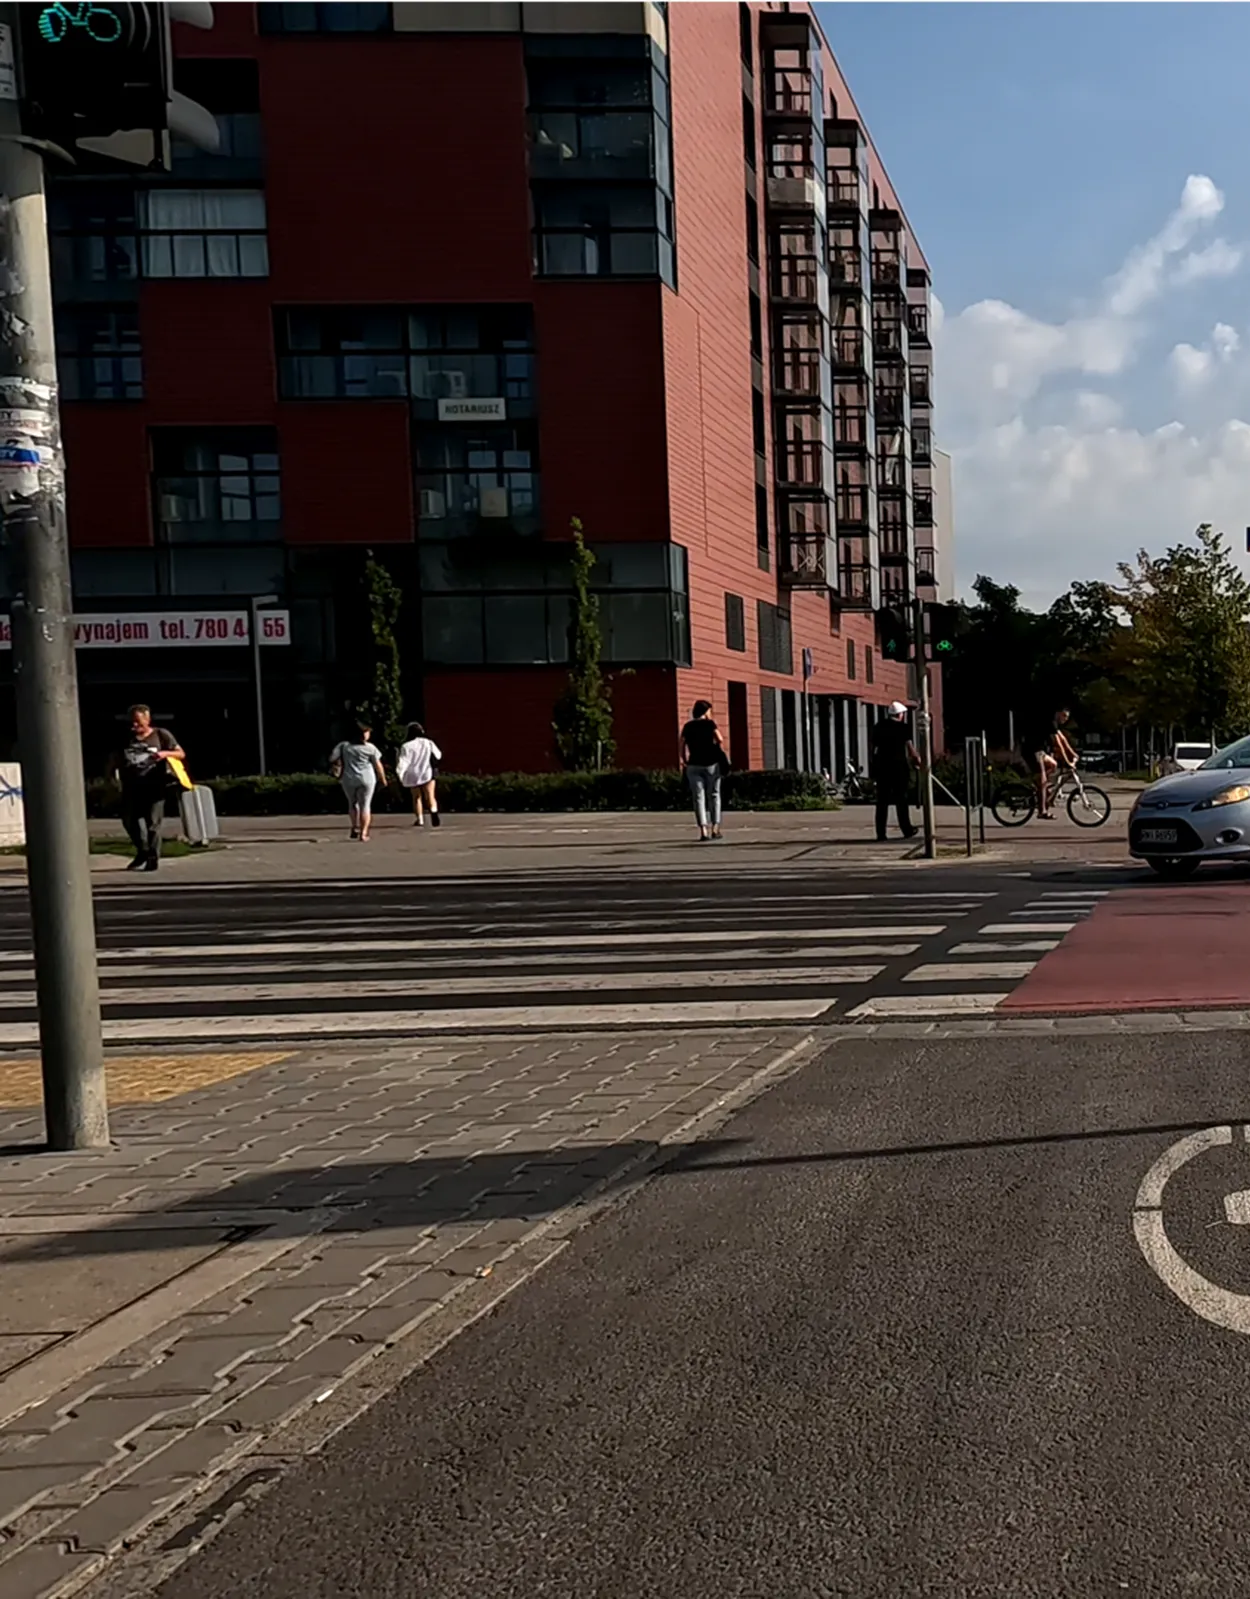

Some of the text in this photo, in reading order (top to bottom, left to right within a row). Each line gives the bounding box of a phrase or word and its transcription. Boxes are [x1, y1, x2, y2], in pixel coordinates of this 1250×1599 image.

[445, 404, 500, 414] NOTARIUSZ
[159, 619, 190, 640] tel.
[194, 618, 228, 638] 780
[263, 617, 285, 637] 55
